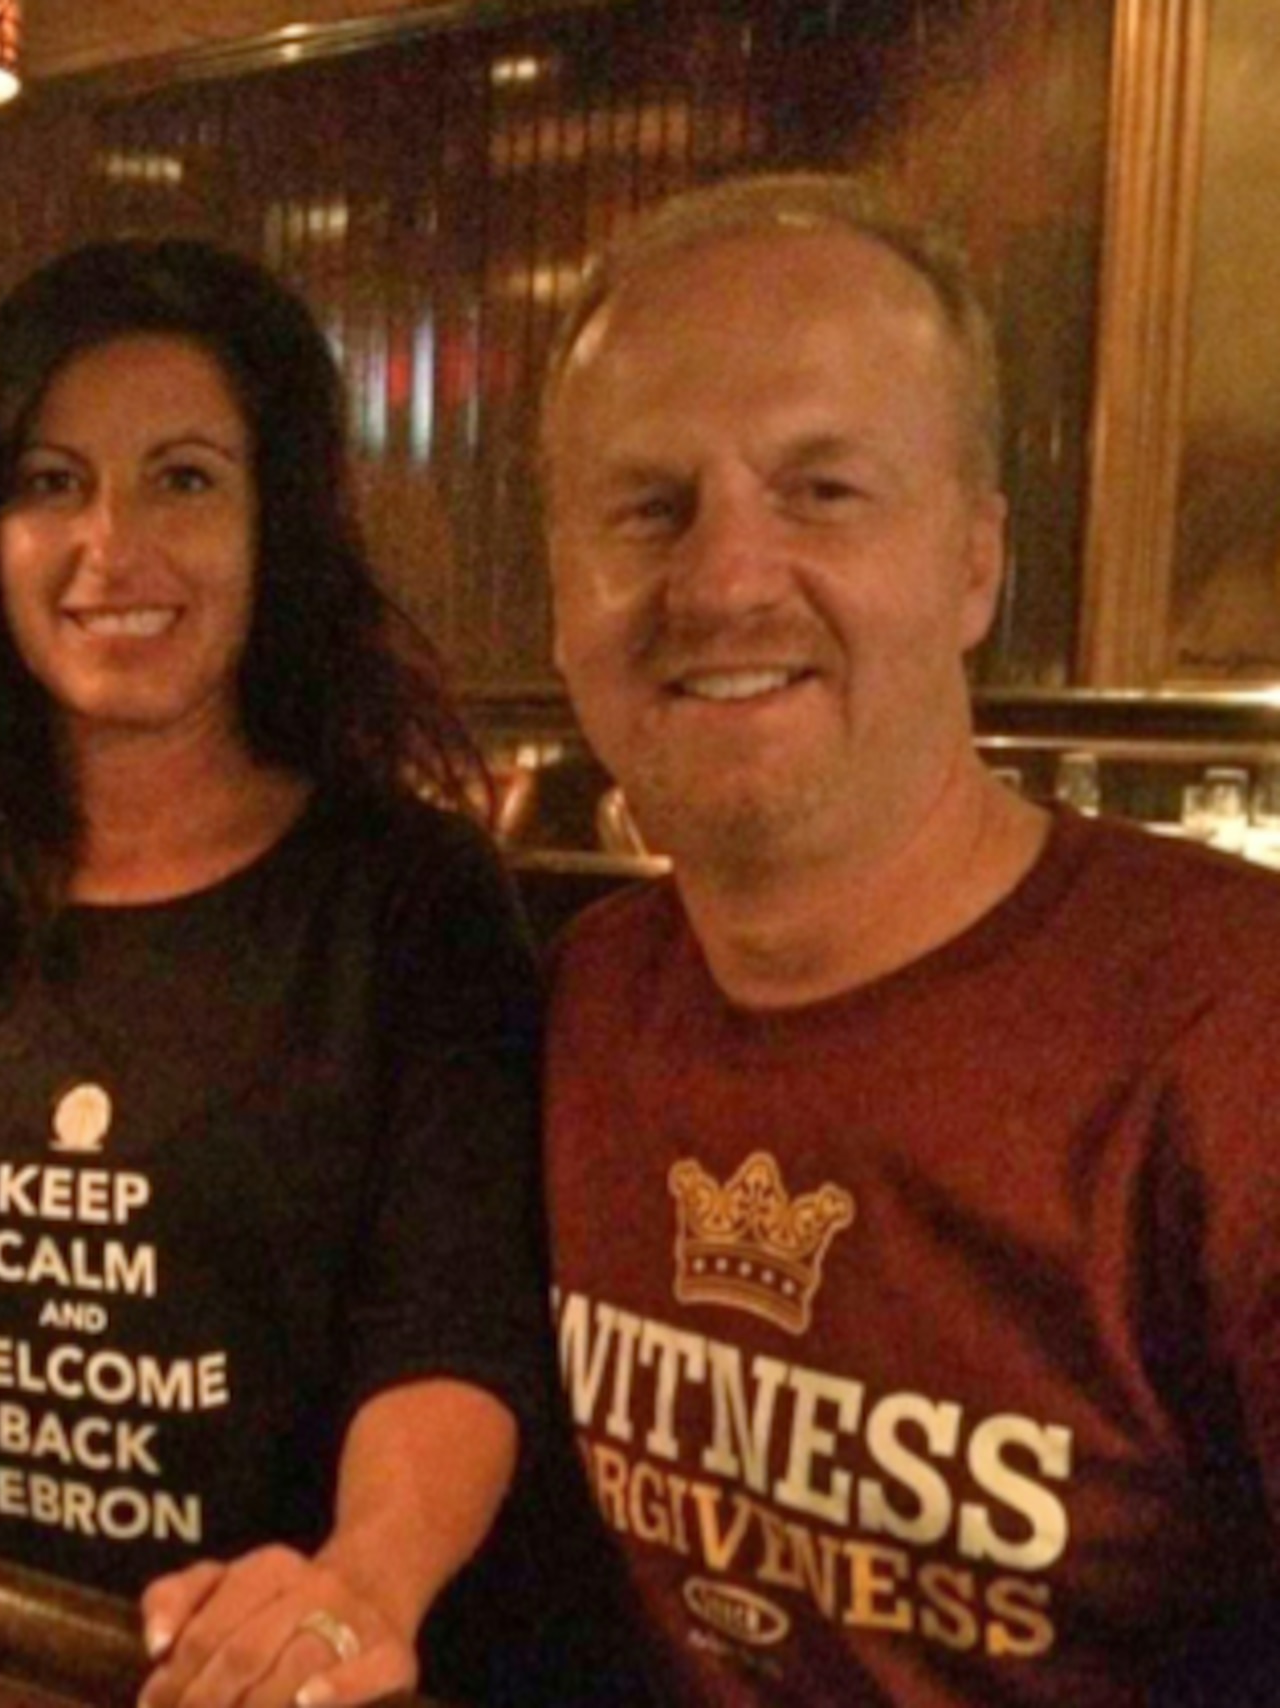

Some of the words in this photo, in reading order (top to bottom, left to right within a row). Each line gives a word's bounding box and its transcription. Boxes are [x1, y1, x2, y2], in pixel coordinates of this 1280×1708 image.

[40, 1301, 107, 1333] AND
[550, 1286, 1072, 1570] WITNESS
[578, 1437, 1055, 1656] RGIVNESS
